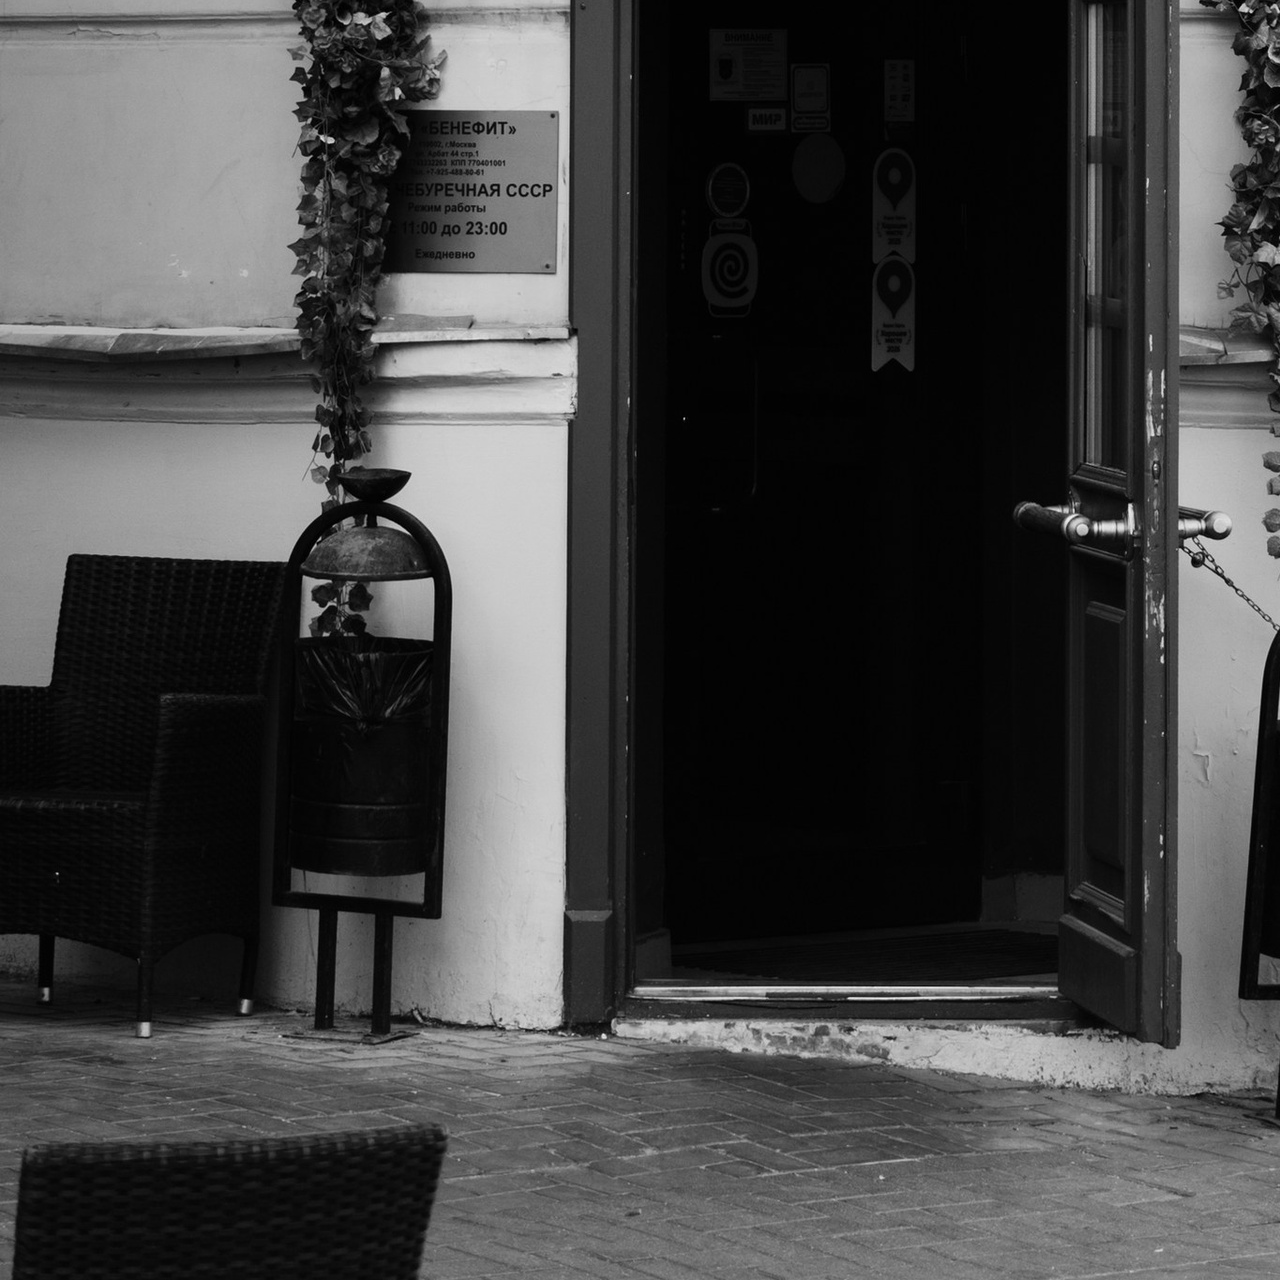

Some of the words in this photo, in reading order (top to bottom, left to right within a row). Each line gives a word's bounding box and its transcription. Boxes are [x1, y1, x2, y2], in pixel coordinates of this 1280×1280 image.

[752, 113, 782, 126] МИР
[421, 121, 517, 136] «БЕНЕФИТ»
[450, 150, 459, 158] 44
[451, 159, 466, 167] КПП
[468, 159, 506, 167] 770401001
[506, 183, 553, 198] СССР
[408, 202, 442, 212] Режим
[444, 203, 486, 214] работы
[402, 221, 437, 235] 11:00
[441, 224, 461, 237] до
[465, 221, 508, 235] 23:00
[415, 248, 475, 260] Ежедневно
